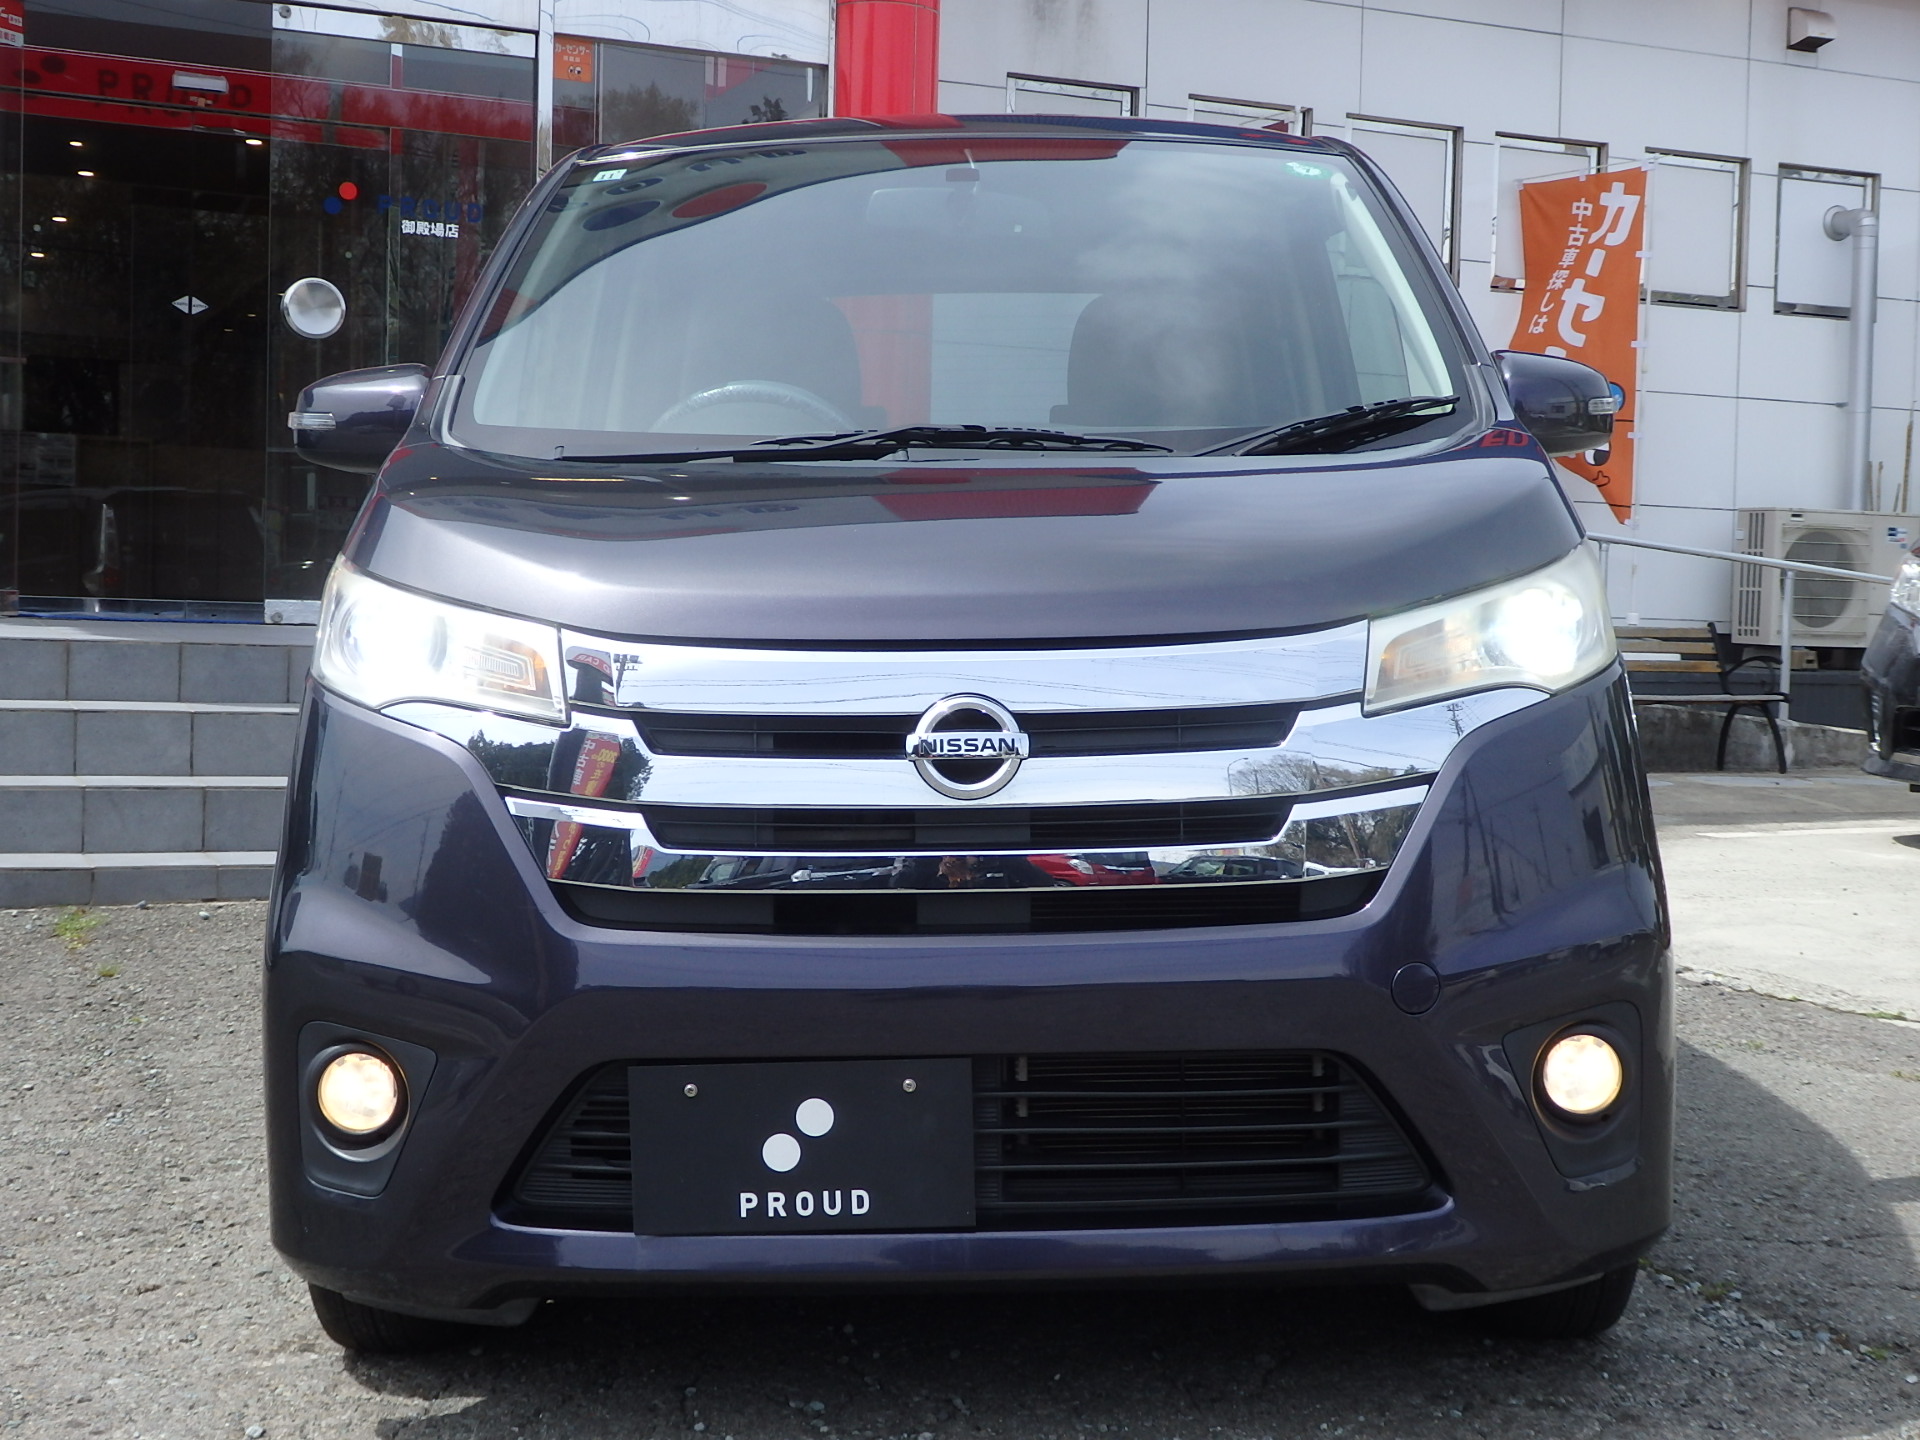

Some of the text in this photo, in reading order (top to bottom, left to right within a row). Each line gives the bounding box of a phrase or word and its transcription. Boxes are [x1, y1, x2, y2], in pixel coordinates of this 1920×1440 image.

[377, 194, 483, 223] PROUD
[401, 219, 459, 238] 御殿場店
[1528, 198, 1593, 333] 中古車探しは
[1545, 182, 1641, 358] カーセ
[919, 738, 1017, 755] NISSAN
[740, 1189, 870, 1218] PROUD
